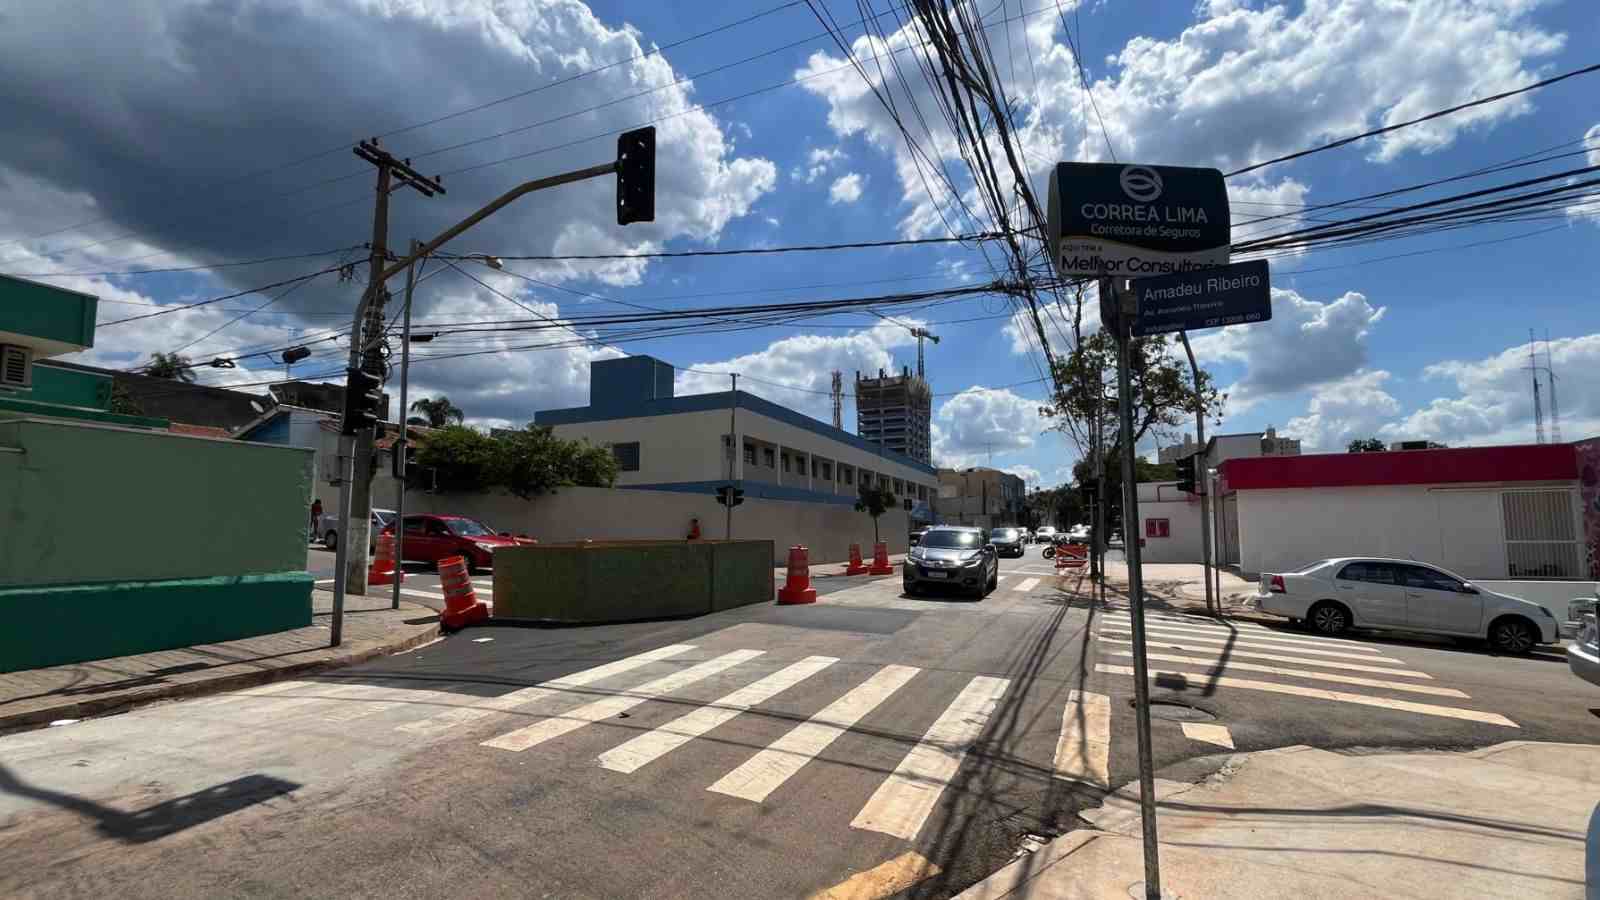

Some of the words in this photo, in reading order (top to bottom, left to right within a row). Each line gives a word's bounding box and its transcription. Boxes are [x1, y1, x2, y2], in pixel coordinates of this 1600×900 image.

[1081, 203, 1160, 222] CORREA
[1166, 206, 1208, 224] LIMA
[1090, 223, 1142, 236] Corretora
[1143, 225, 1157, 236] de
[1158, 226, 1201, 240] Seguros
[1061, 255, 1124, 272] Melhor
[1143, 283, 1202, 302] Amadeu
[1206, 274, 1260, 293] Ribeiro
